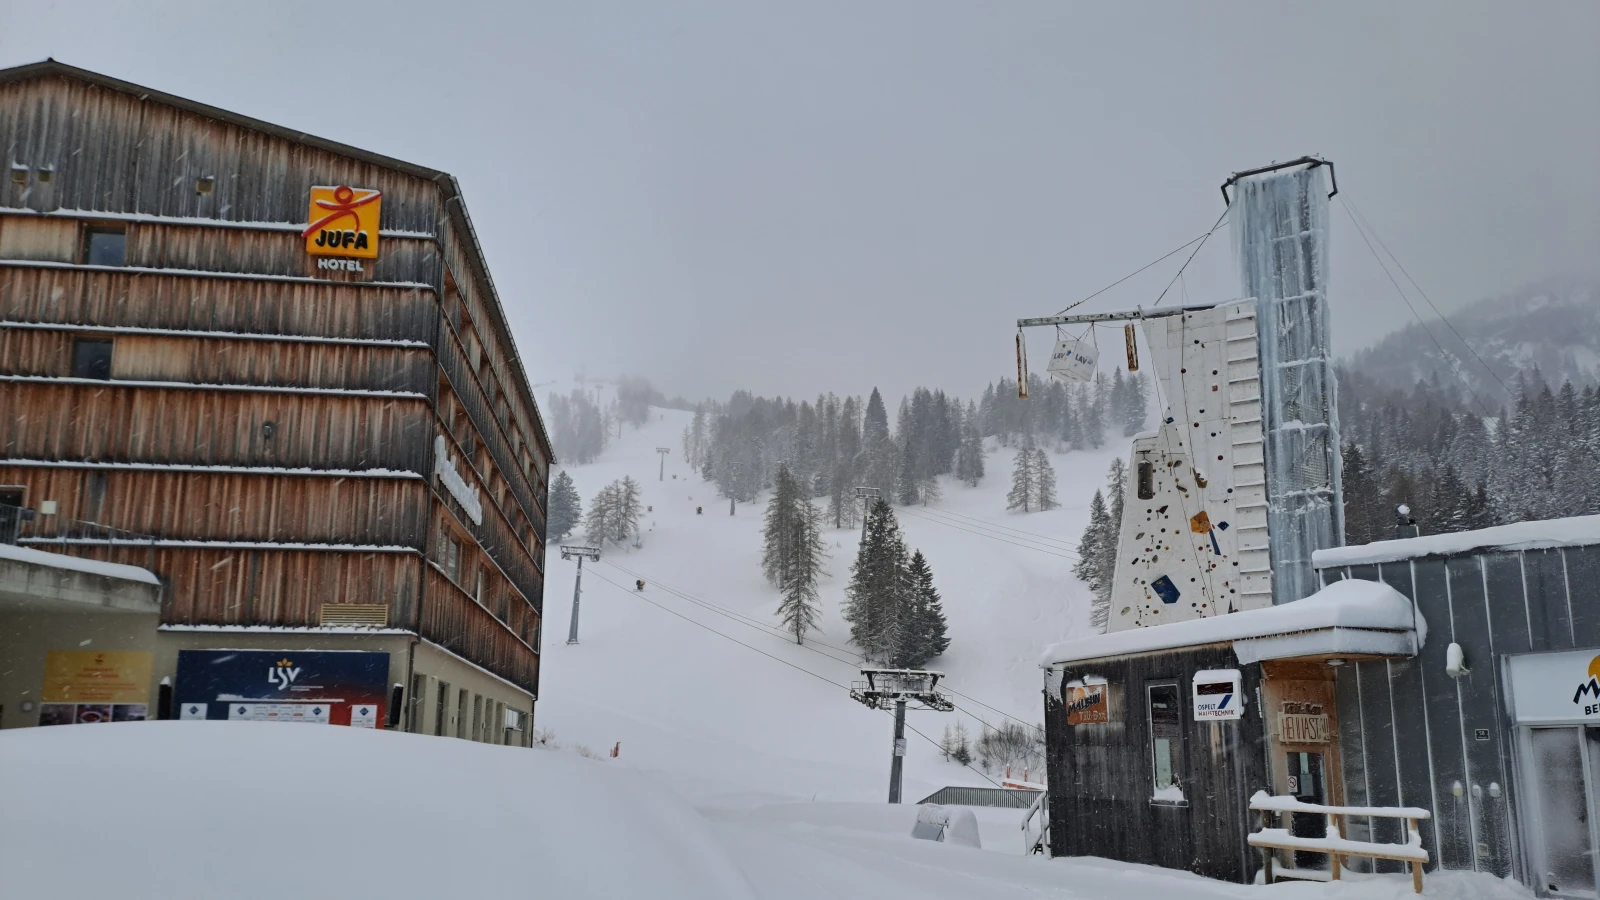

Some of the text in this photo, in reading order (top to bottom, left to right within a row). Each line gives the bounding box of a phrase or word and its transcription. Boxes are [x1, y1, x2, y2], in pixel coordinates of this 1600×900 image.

[315, 229, 368, 250] JUFA
[317, 258, 364, 272] HOTEL
[1053, 352, 1066, 360] LAV
[1075, 354, 1087, 364] LAV
[268, 666, 301, 691] LSV
[1573, 678, 1600, 704] M
[1197, 703, 1216, 711] OSPELT
[1198, 709, 1235, 717] HAUSTECHNIK
[1585, 703, 1600, 715] BE
